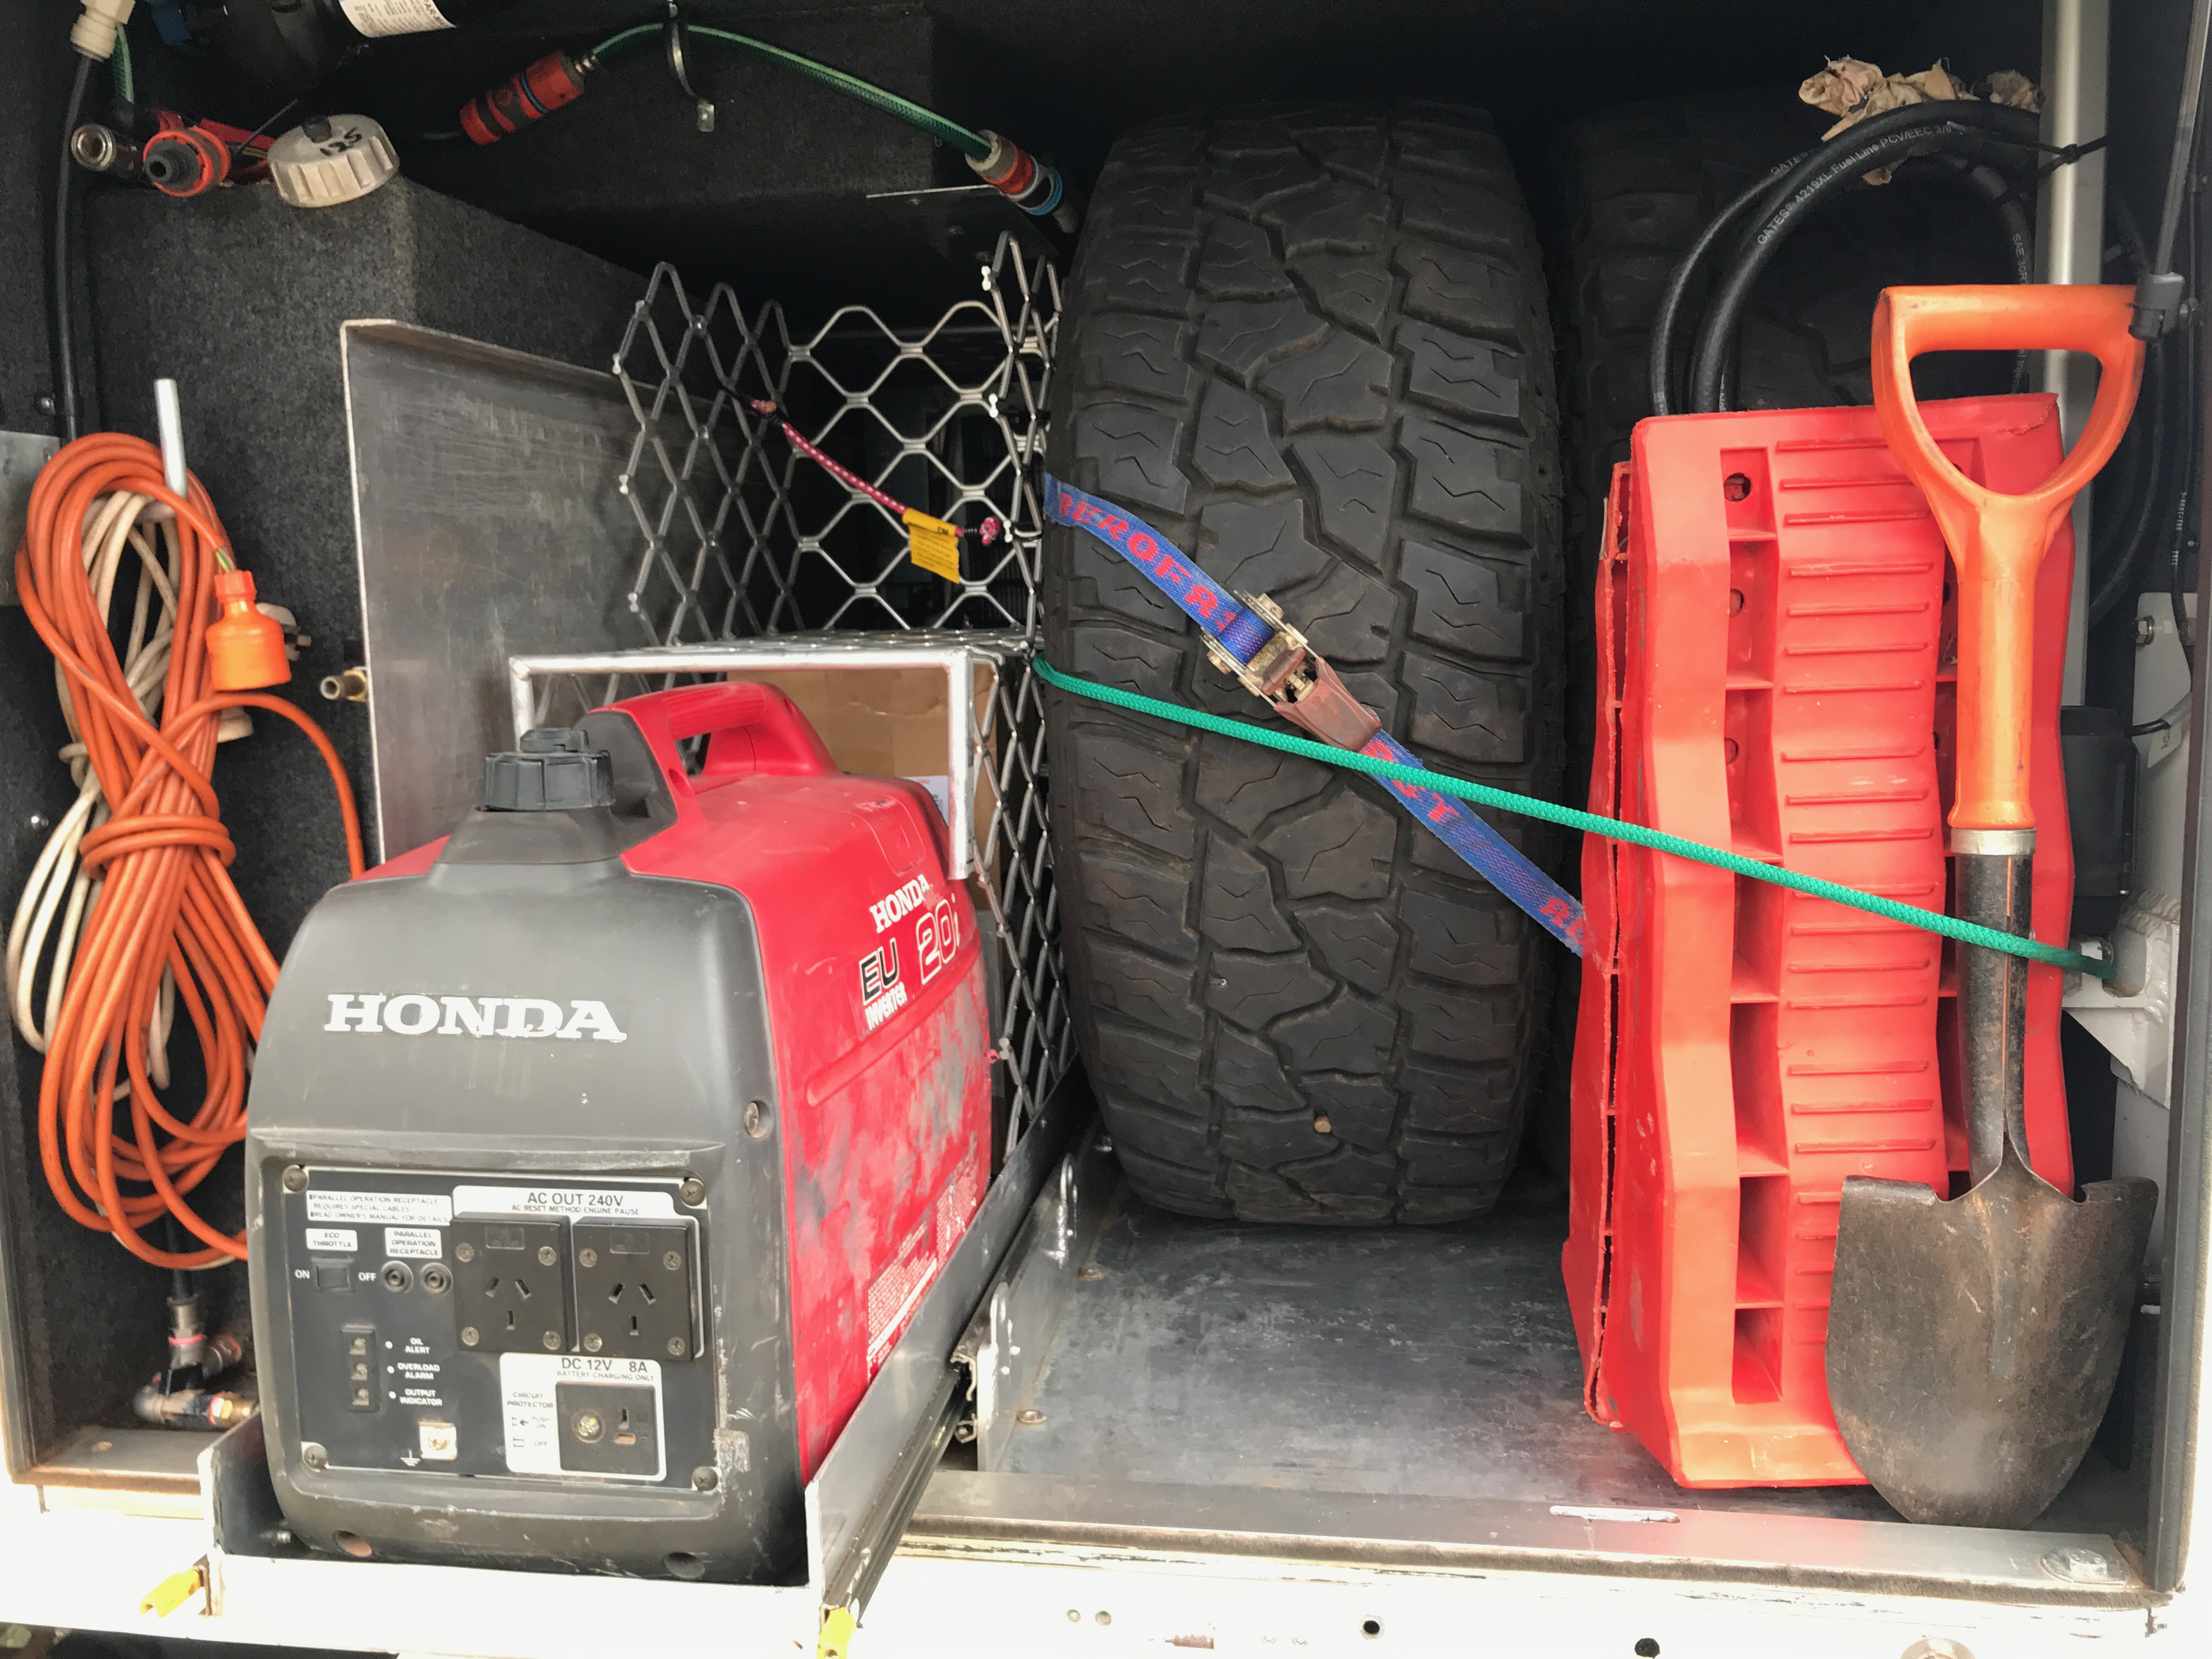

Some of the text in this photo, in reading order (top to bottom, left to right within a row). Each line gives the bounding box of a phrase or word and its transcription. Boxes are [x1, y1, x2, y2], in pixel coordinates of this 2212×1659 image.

[869, 873, 931, 933] HONDA
[859, 936, 900, 1006] EU
[864, 981, 908, 1031] INVERTER
[324, 993, 628, 1043] HONDA
[393, 1197, 437, 1205] RECEPTACLE
[527, 1192, 623, 1206] AC OUT 240V
[313, 1240, 352, 1248] THROTTLE
[294, 1269, 310, 1279] ON
[358, 1272, 377, 1282] OFF
[410, 1337, 424, 1345] OIL
[405, 1345, 431, 1354] ALERT
[397, 1362, 441, 1373] OVERLOAD
[561, 1357, 647, 1373] DC 12V 8A
[404, 1371, 434, 1380] ALARM
[593, 1372, 633, 1380] CHARGING
[404, 1388, 436, 1397] OUTPUT
[399, 1396, 443, 1407] INDICATOR
[507, 1401, 554, 1409] PROTECTOR
